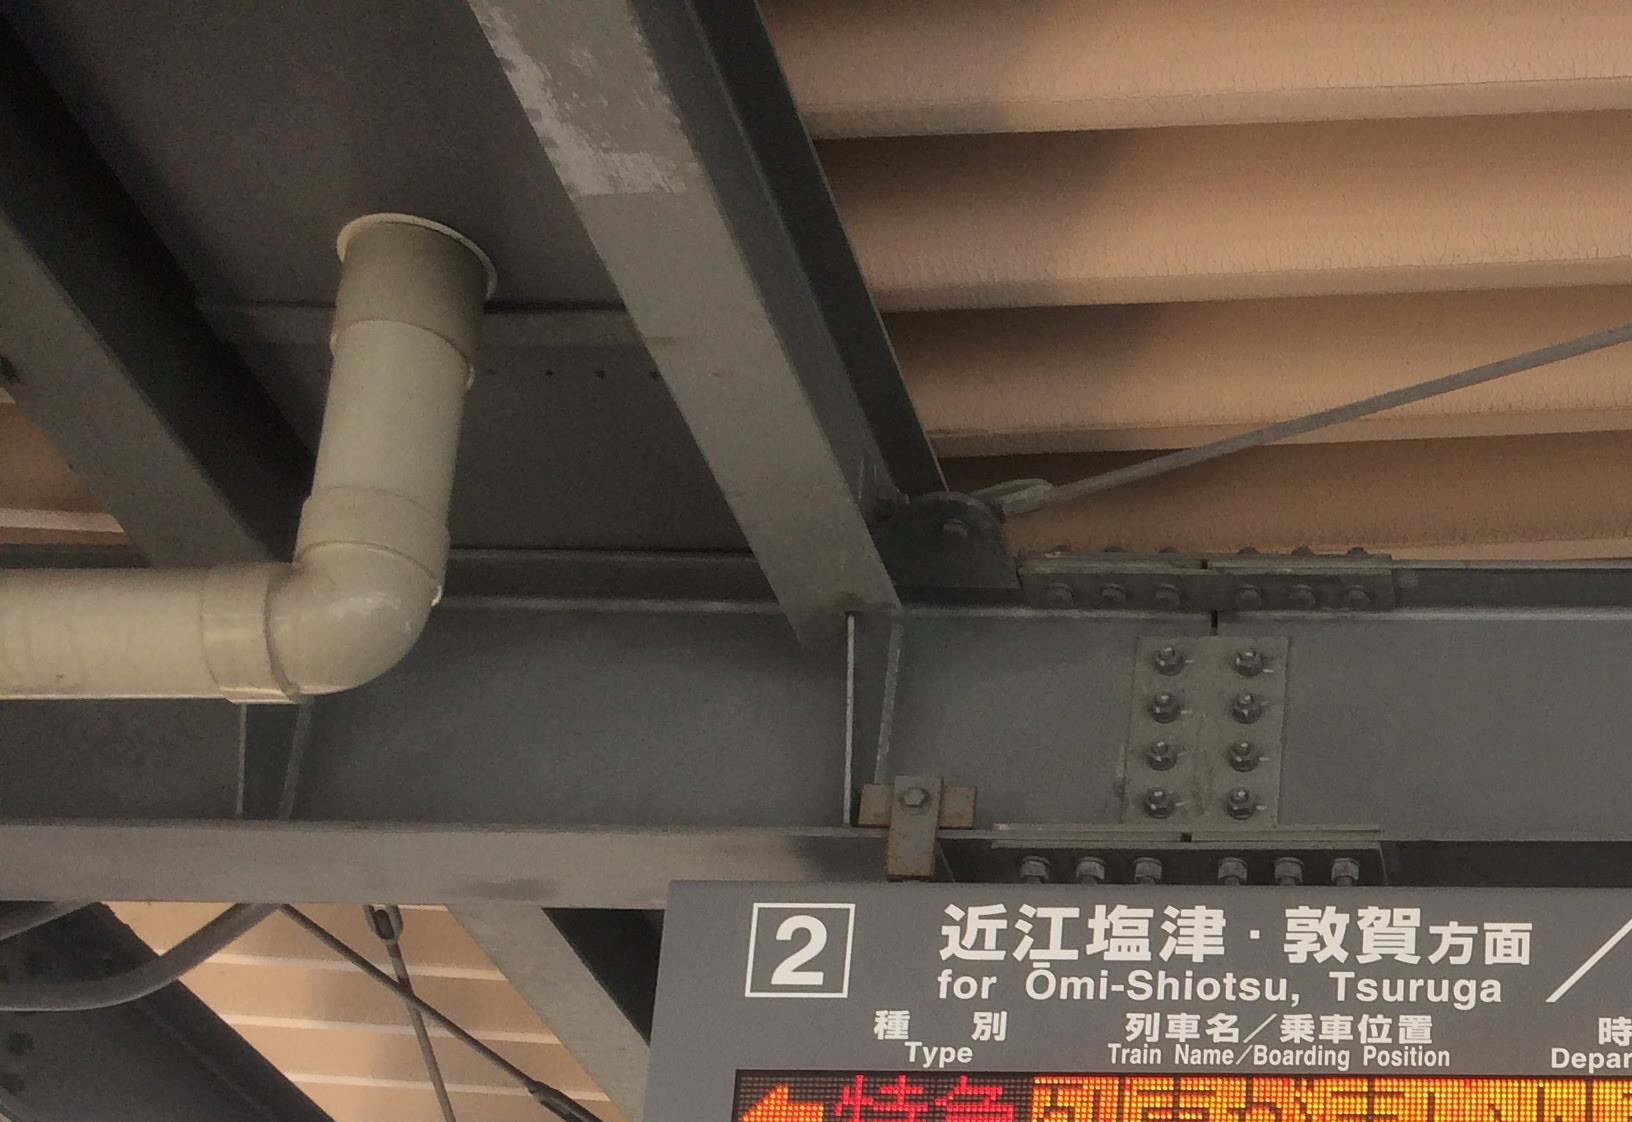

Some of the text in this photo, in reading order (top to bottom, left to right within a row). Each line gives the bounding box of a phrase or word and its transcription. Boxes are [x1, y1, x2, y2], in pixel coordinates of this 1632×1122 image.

[770, 915, 827, 985] 2
[937, 968, 997, 1000] for
[1329, 971, 1502, 1011] Tsuruga
[904, 1041, 974, 1068] Type
[1107, 1043, 1162, 1065] Train
[1363, 1045, 1450, 1067] Position
